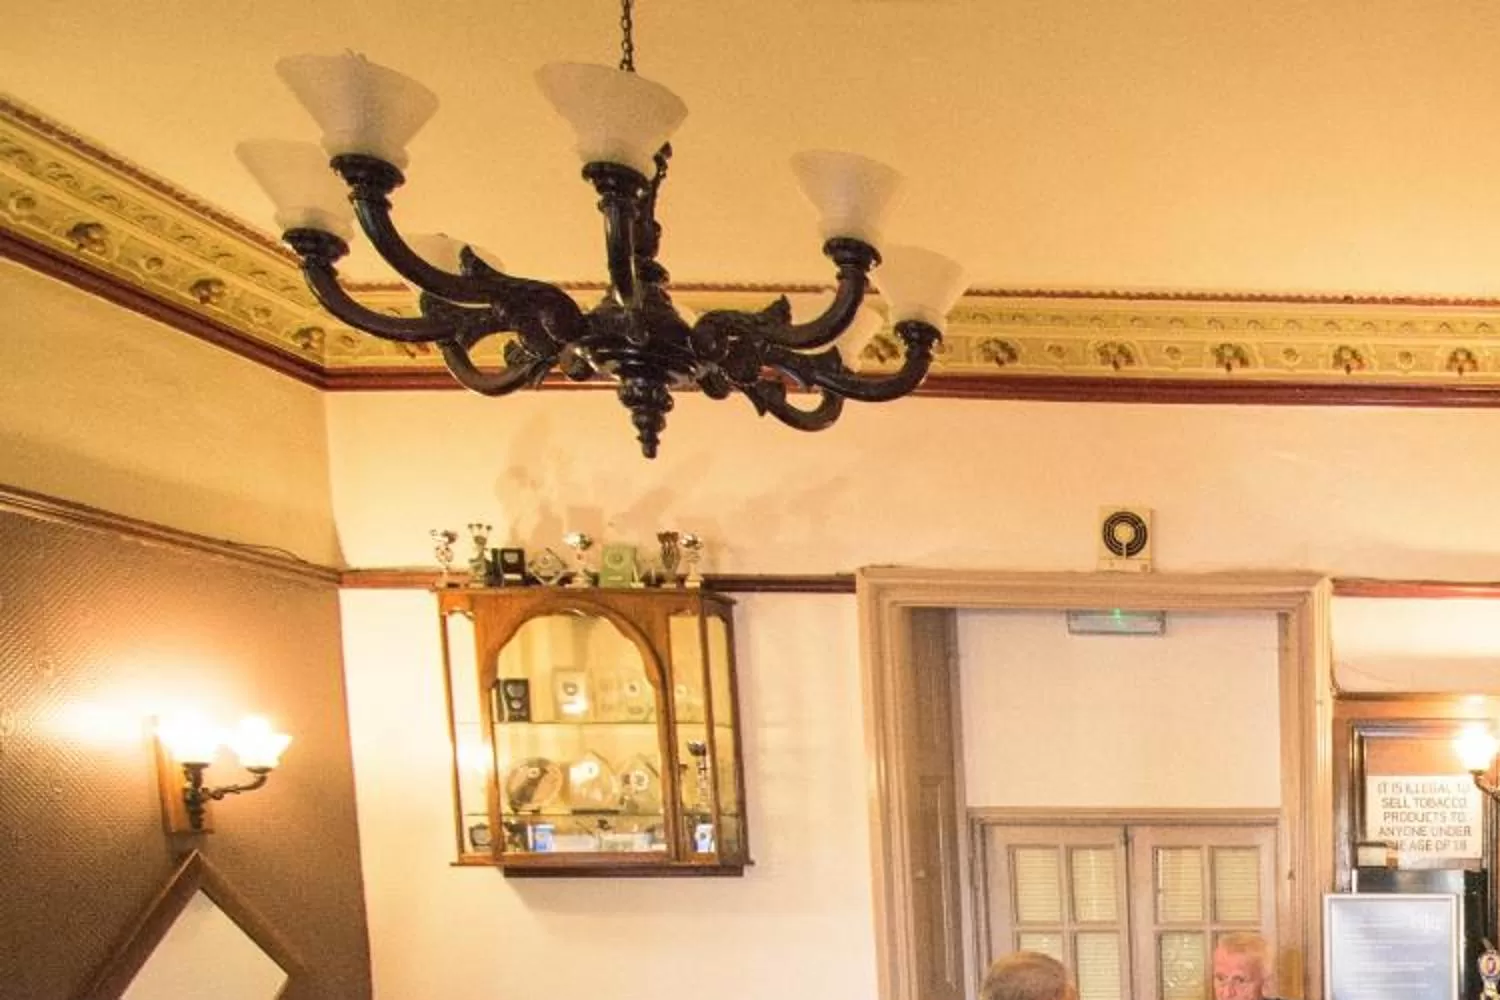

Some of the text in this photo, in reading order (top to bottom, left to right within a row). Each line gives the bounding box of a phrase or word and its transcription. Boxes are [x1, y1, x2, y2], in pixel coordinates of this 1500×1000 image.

[1381, 797, 1468, 809] SELL TOBACCO
[1383, 811, 1466, 823] PRODUCTS TO
[1379, 825, 1473, 837] ANYONE UNDER
[1410, 840, 1432, 851] AGE
